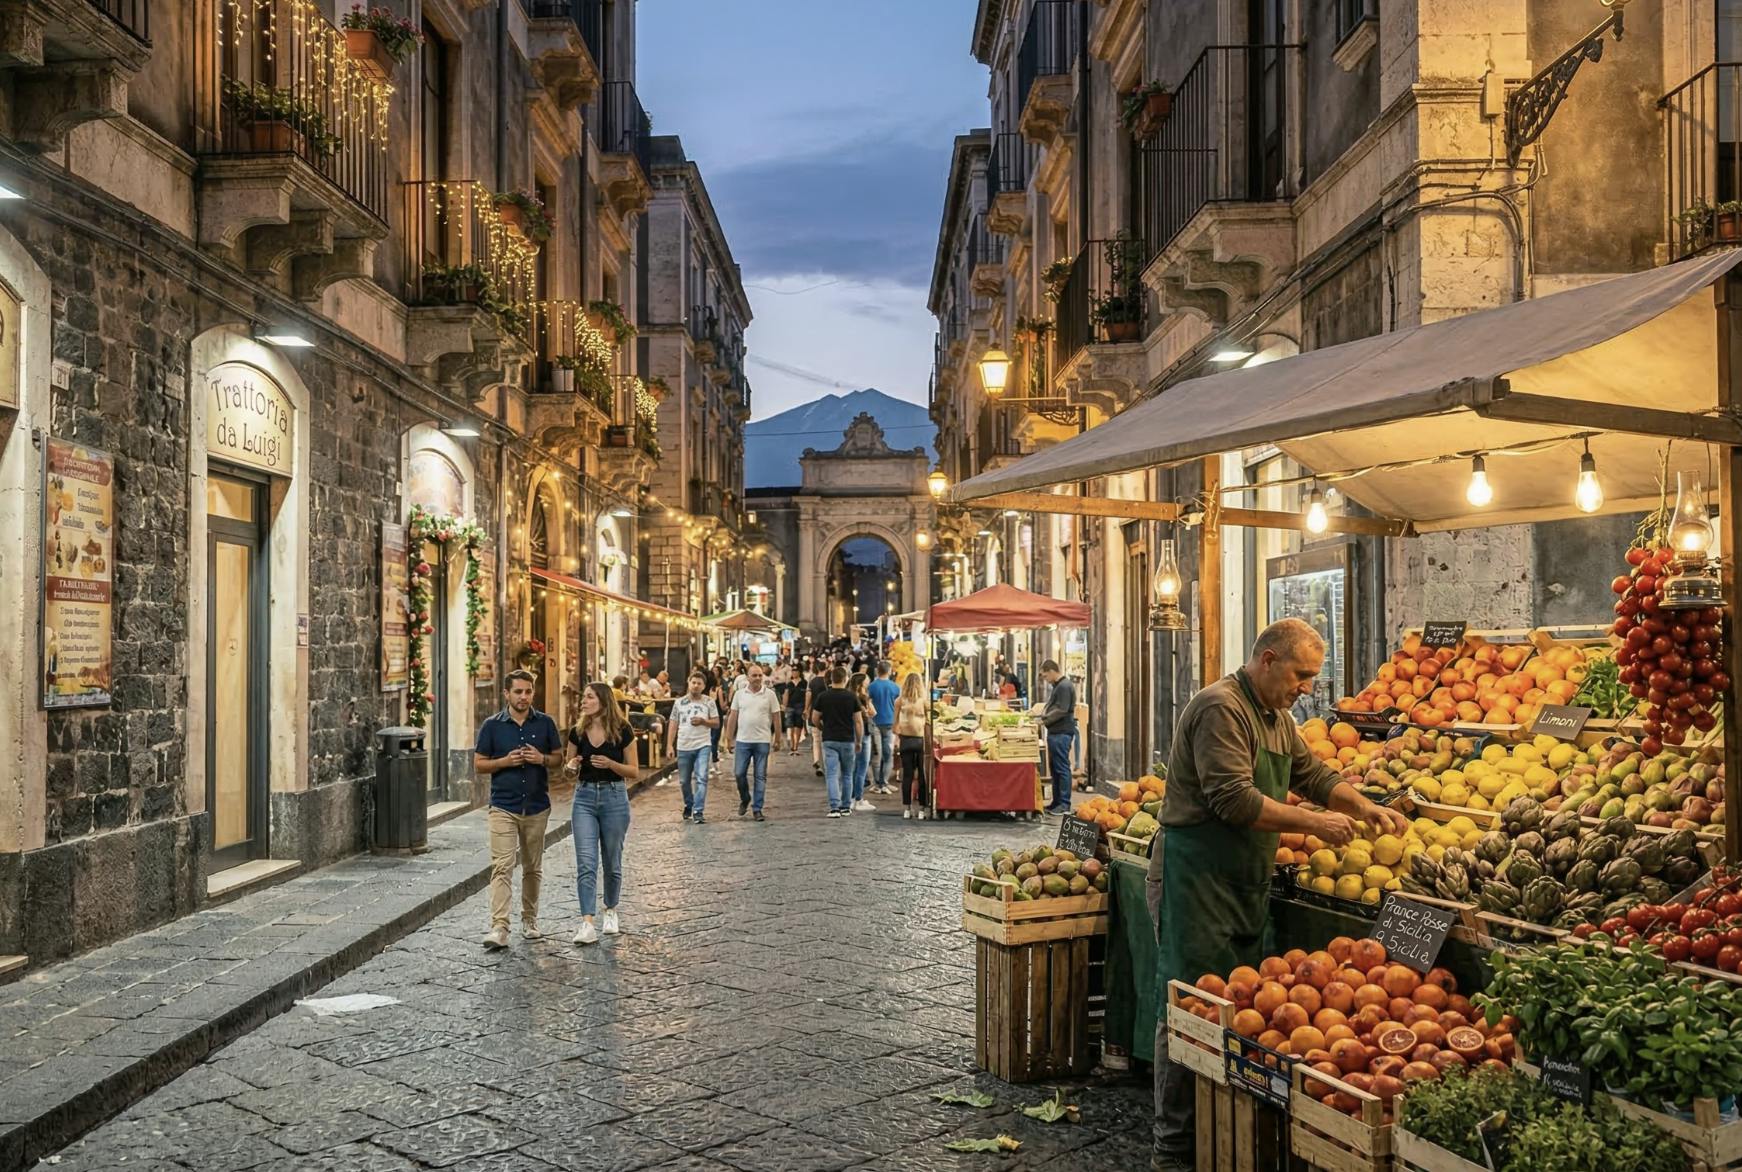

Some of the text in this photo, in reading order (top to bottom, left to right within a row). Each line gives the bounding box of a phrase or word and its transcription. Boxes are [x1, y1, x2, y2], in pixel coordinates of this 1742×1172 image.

[211, 378, 288, 436] Trattoria
[217, 417, 281, 466] da Luigi
[1539, 711, 1577, 727] Limoni
[1382, 916, 1432, 944] di Sicilia
